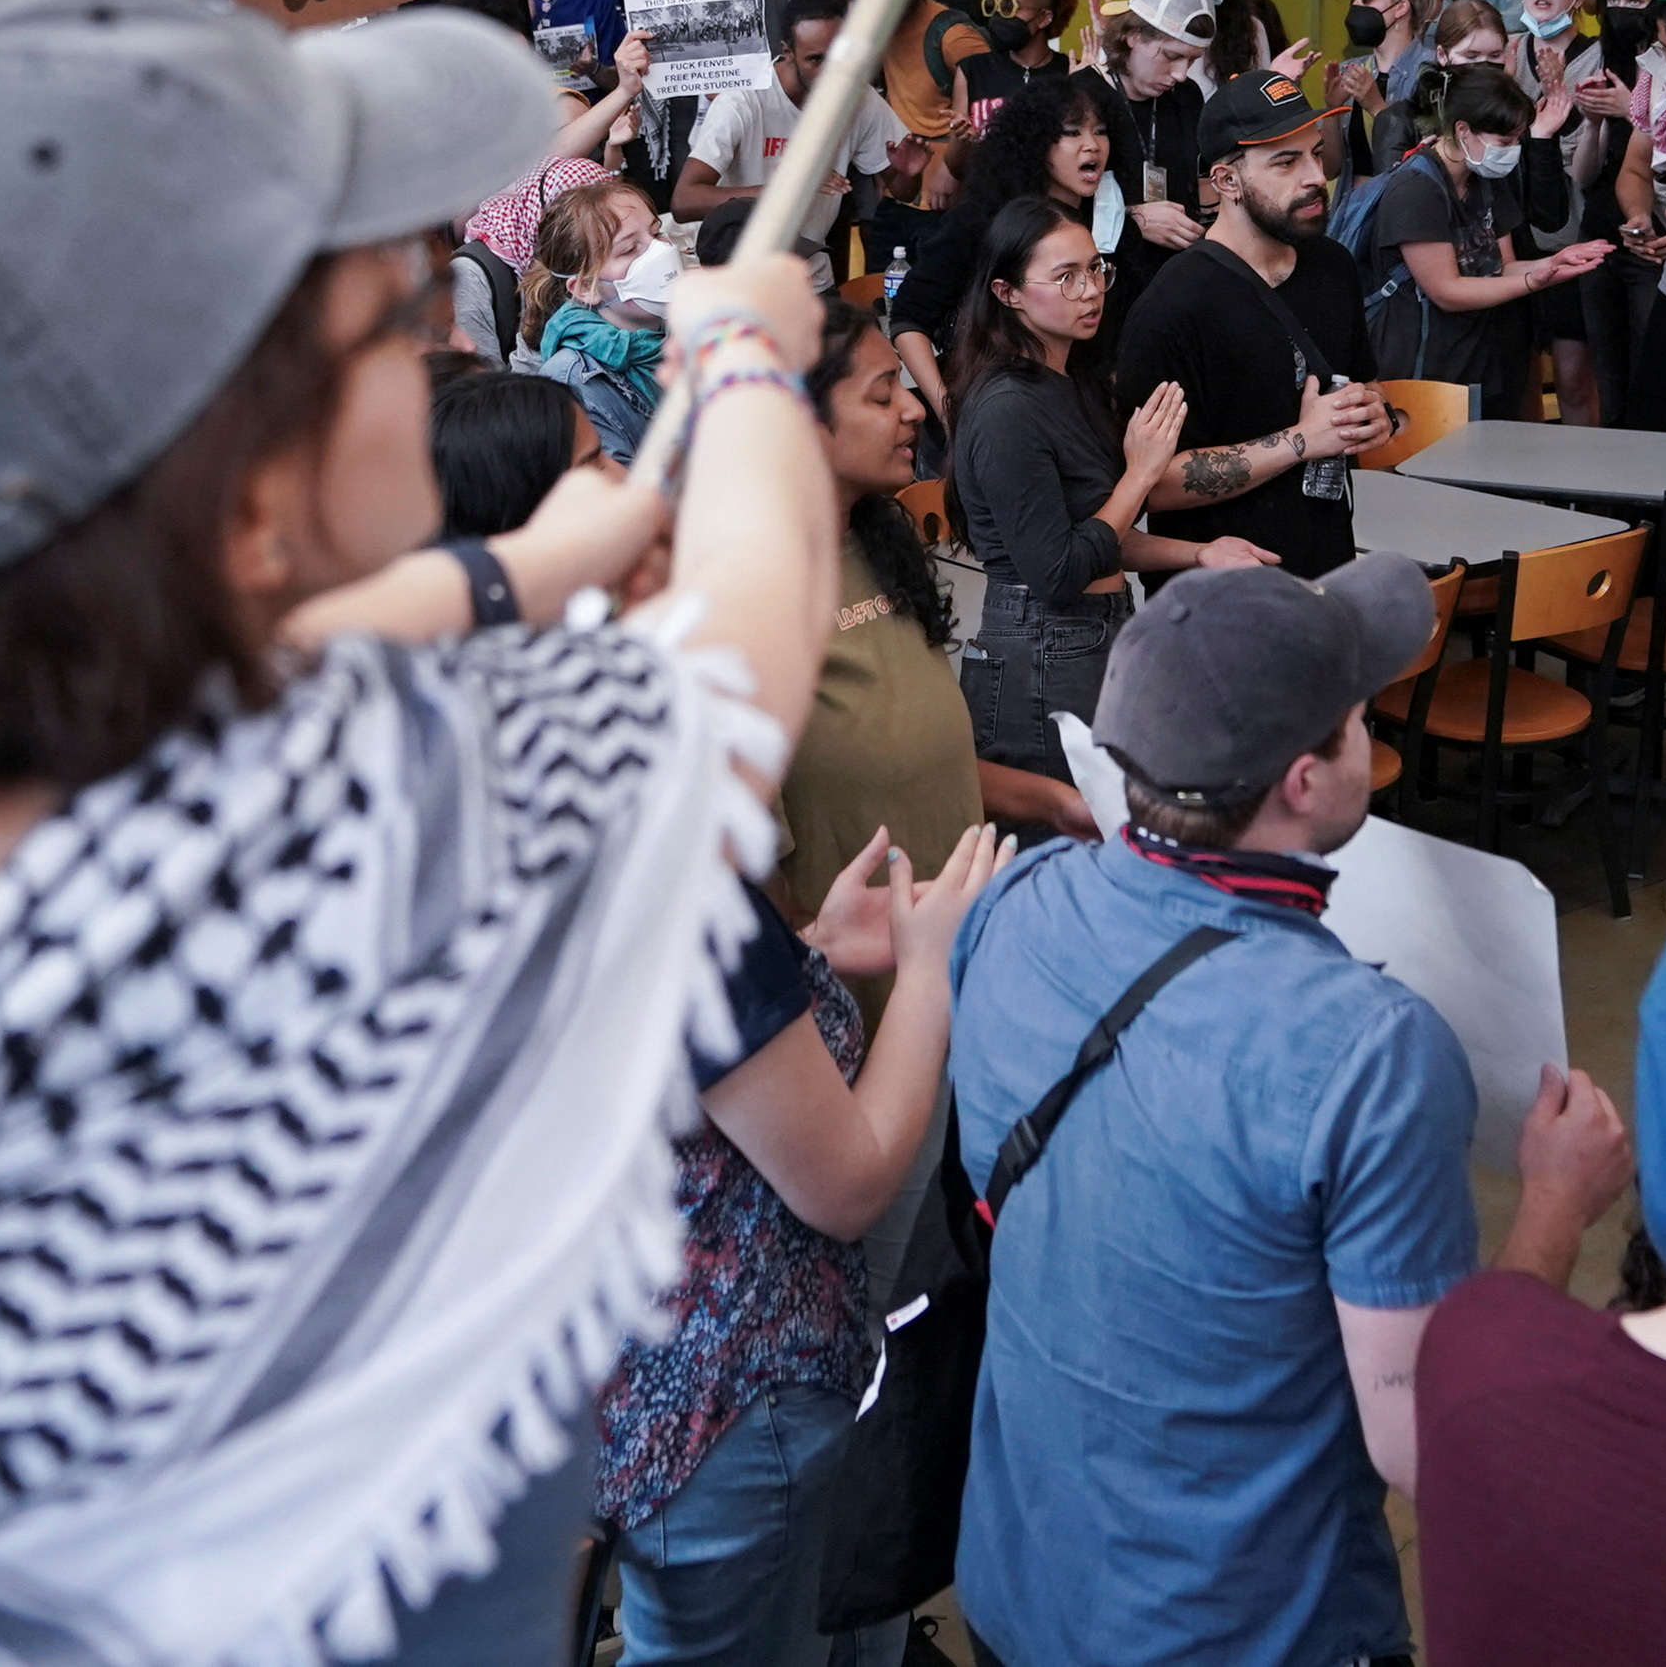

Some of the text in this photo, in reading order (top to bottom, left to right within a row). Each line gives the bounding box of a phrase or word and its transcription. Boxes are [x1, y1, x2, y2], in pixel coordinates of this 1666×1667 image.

[644, 0, 665, 8] THIS
[670, 58, 734, 71] FUCK FENVES
[665, 69, 740, 82] FREE PALESTINE
[657, 79, 752, 95] FREE OUR STUDENTS
